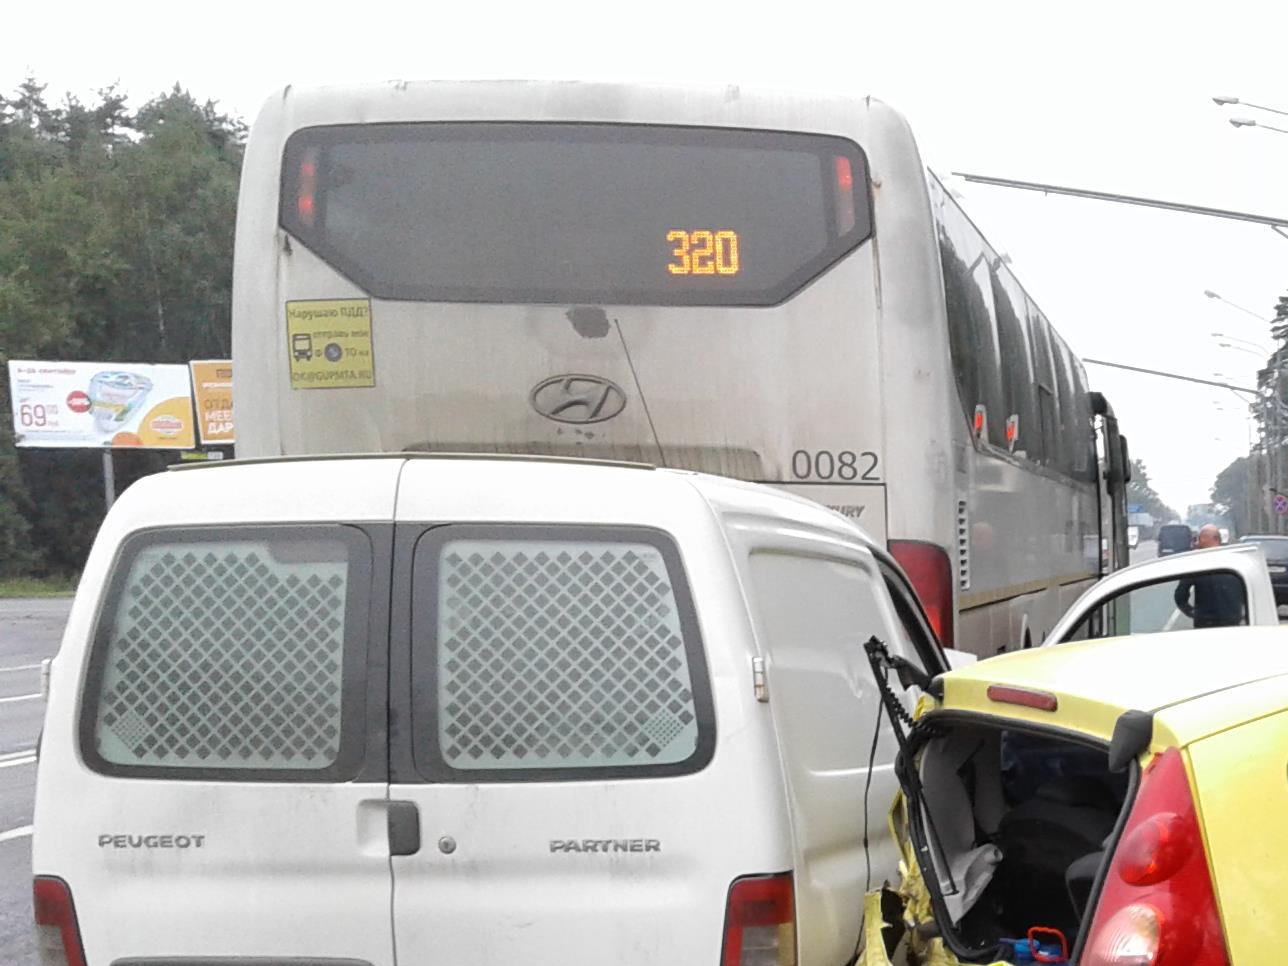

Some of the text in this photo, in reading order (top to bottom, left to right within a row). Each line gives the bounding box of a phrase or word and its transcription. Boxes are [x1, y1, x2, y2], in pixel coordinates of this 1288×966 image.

[667, 230, 738, 274] 320
[20, 404, 46, 427] 69
[208, 422, 234, 433] ДАР
[792, 450, 880, 480] 0082
[98, 834, 205, 848] PEUGEOT
[549, 839, 661, 853] PARTNER
